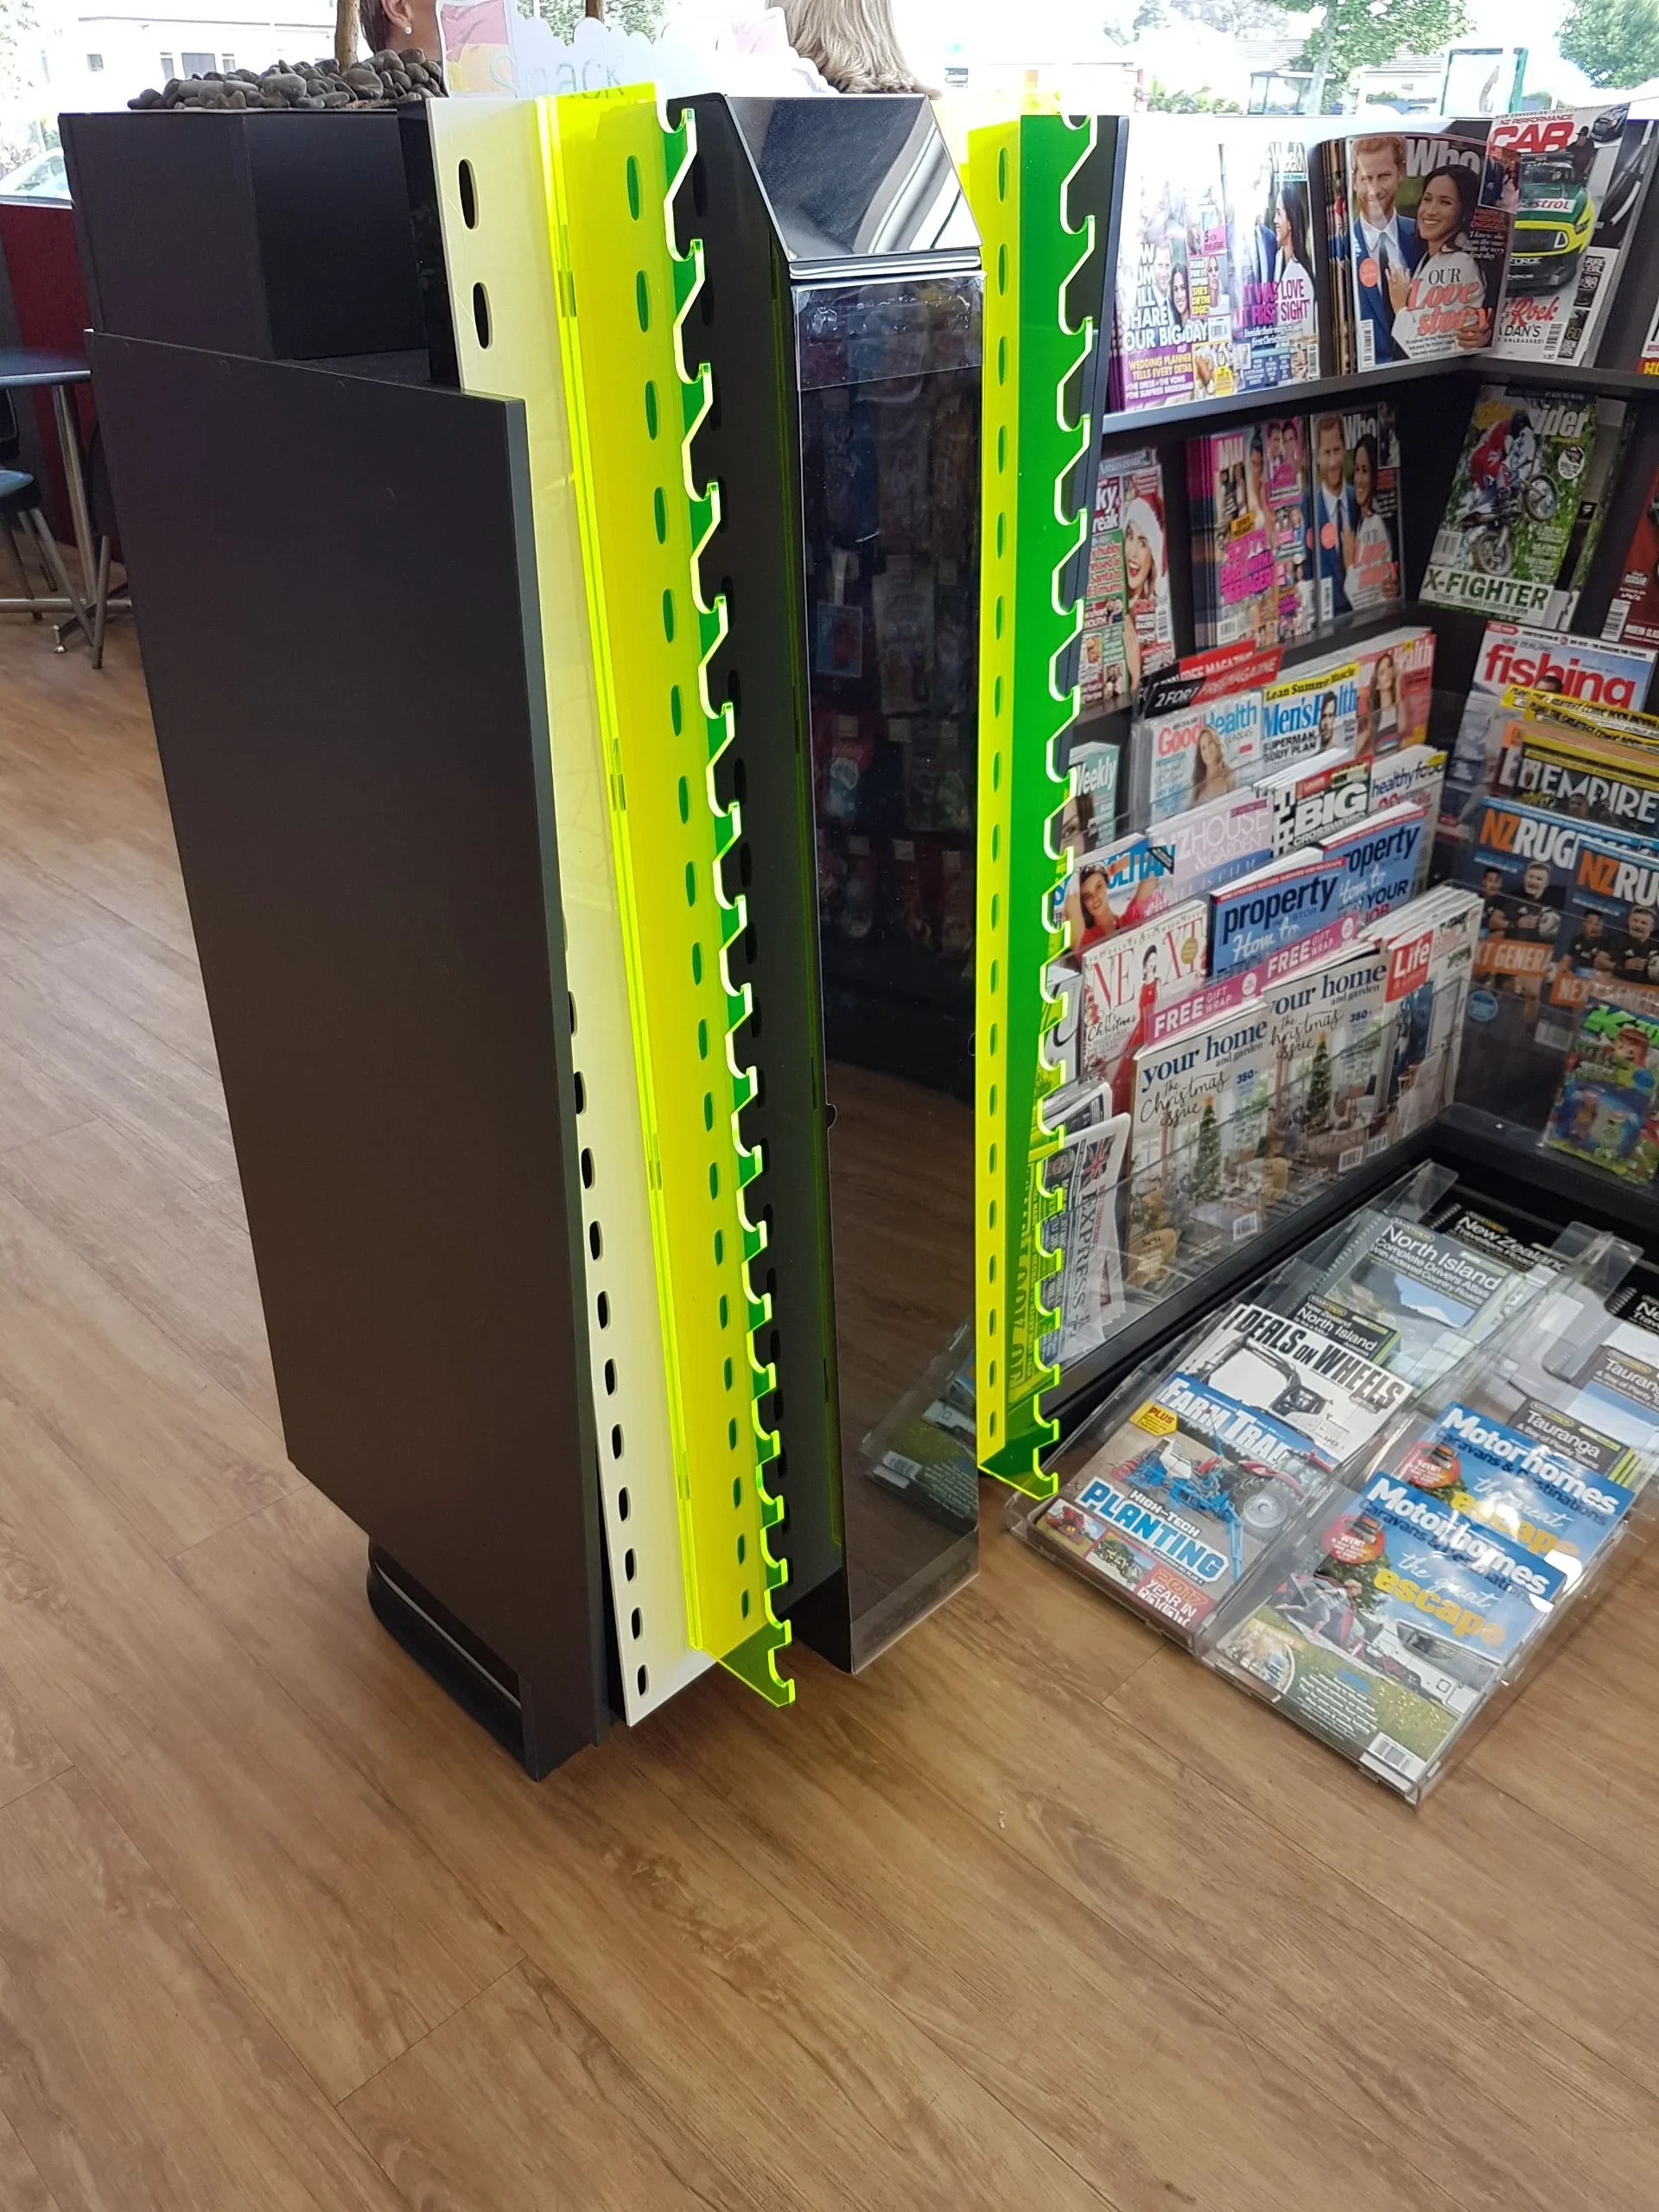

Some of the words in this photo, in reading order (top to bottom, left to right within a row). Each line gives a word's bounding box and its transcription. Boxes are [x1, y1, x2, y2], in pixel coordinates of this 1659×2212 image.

[1491, 122, 1575, 153] CAR
[1407, 138, 1480, 178] Who
[1518, 198, 1571, 209] astrol
[1281, 278, 1305, 300] LOVE
[1408, 277, 1480, 311] Love
[1428, 268, 1461, 285] OUR
[1123, 306, 1170, 330] SHARE
[1417, 305, 1493, 336] story
[1510, 296, 1561, 327] Rock
[1123, 328, 1156, 352] OUR
[1160, 325, 1182, 345] BIG
[1181, 321, 1210, 343] DAY
[1128, 355, 1163, 372] WEDDING
[1164, 353, 1193, 365] PLANNER
[1132, 368, 1153, 381] TELLS
[1153, 366, 1173, 378] EVERY
[1528, 400, 1589, 438] ider
[1425, 567, 1549, 612] X-FIGHTER
[1265, 684, 1291, 702] Lean
[1158, 715, 1204, 758] Good
[1203, 700, 1258, 735] Health
[1262, 696, 1313, 741] Men's
[1290, 739, 1316, 756] PLAN
[1296, 782, 1368, 834] BIG
[1541, 764, 1659, 823] EMPIRE
[1478, 808, 1522, 852] NZ
[1344, 825, 1421, 878] operty
[1577, 849, 1621, 897] NZ
[1223, 875, 1339, 945] property
[1367, 879, 1409, 909] YOUR
[1233, 931, 1276, 963] How
[1312, 930, 1331, 947] GIFT
[1312, 938, 1334, 957] WRAP
[1268, 939, 1312, 979] FREE
[1394, 939, 1431, 980] Life
[1207, 986, 1228, 1003] GIFT
[1320, 963, 1388, 1000] home
[1346, 983, 1381, 1001] garden
[1154, 996, 1205, 1039] FREE
[1205, 995, 1232, 1014] WRAP
[1270, 1009, 1344, 1047] hristmas
[1141, 1048, 1200, 1093] your
[1205, 1020, 1268, 1063] home
[1215, 1053, 1233, 1068] and
[1233, 1041, 1264, 1061] garden
[1140, 1071, 1230, 1123] Christmas
[1455, 1216, 1502, 1241] New
[1071, 1191, 1098, 1308] EXPRESS
[1375, 1236, 1424, 1266] Complete
[1425, 1262, 1463, 1286] Drivers
[1462, 1281, 1492, 1298] Atlas
[1382, 1224, 1438, 1261] North
[1438, 1253, 1503, 1291] Island
[1421, 1269, 1457, 1292] Country
[1296, 1306, 1334, 1332] North
[1334, 1325, 1378, 1351] Island
[1234, 1307, 1307, 1355] DEALS
[1292, 1344, 1319, 1366] ON
[1313, 1344, 1406, 1409] WHEELS
[1148, 1406, 1174, 1424] PLUS
[1156, 1376, 1231, 1431] FARM
[1527, 1409, 1600, 1459] Tauranga
[1441, 1407, 1620, 1516] Motorhomes
[1079, 1479, 1225, 1581] PLANTING
[1129, 1490, 1201, 1539] HIGH-TECH
[1359, 1498, 1429, 1541] Caravans
[1398, 1551, 1432, 1578] the
[1146, 1579, 1182, 1607] YEAR
[1180, 1603, 1198, 1618] IN
[1154, 1568, 1210, 1605] 2017
[1373, 1567, 1508, 1647] escape
